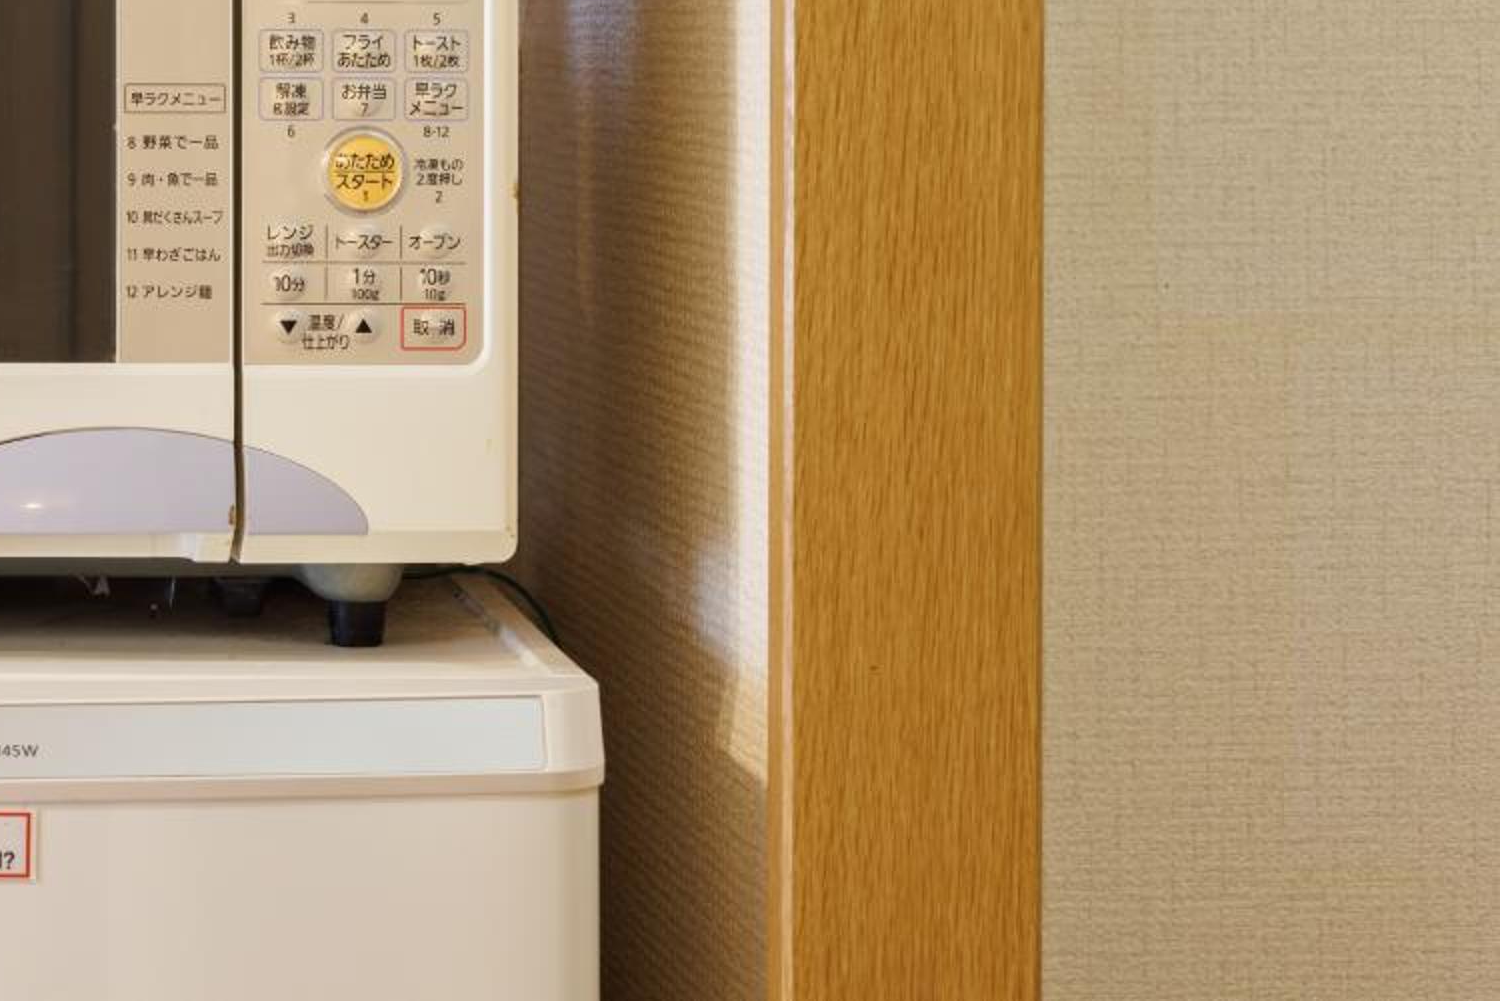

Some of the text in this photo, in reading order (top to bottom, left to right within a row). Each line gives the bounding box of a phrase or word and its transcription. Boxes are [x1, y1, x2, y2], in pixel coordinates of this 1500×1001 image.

[287, 12, 296, 24] 3
[359, 12, 369, 24] 4
[432, 12, 441, 25] 5
[269, 34, 316, 50] 飲み物
[343, 34, 384, 50] フライ
[412, 35, 461, 50] トースト
[337, 52, 391, 68] あたため
[341, 84, 387, 100] お弁当
[415, 82, 458, 97] 早ラク
[360, 103, 369, 116] 7
[409, 101, 464, 117] メニュー
[287, 126, 296, 138] 6
[127, 172, 137, 186] 9
[336, 174, 393, 190] スタート
[435, 191, 443, 203] 2
[126, 210, 139, 224] 10
[267, 224, 314, 240] レンジ
[335, 234, 394, 250] トースター
[409, 234, 461, 250] オープン
[127, 248, 137, 261] 11
[275, 275, 305, 292] 10分
[353, 267, 375, 285] 1分
